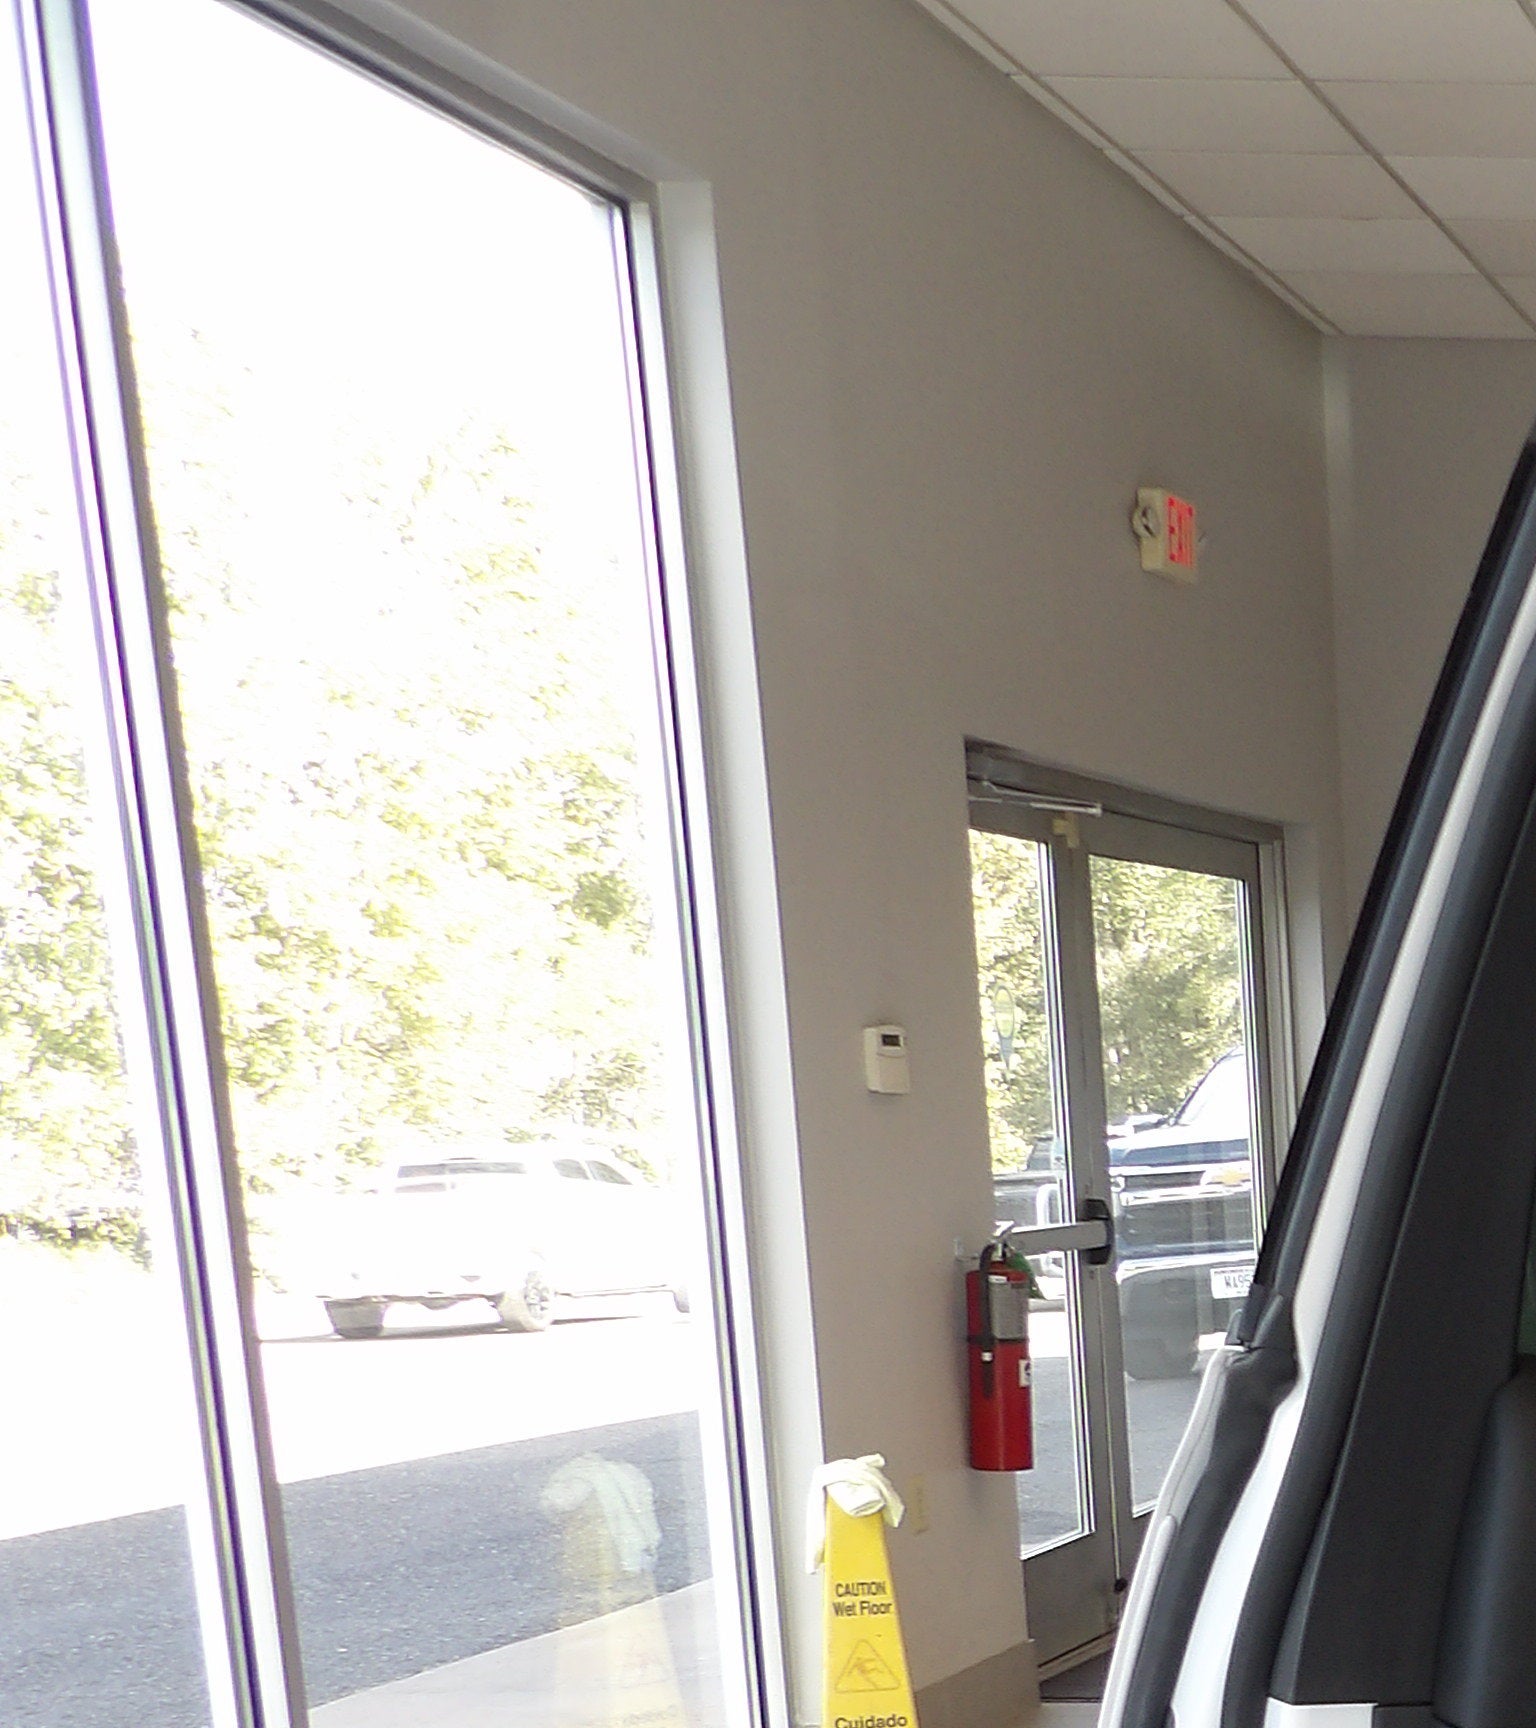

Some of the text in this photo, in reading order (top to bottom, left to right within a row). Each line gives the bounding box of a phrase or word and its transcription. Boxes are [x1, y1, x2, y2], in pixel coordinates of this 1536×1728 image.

[835, 1581, 887, 1597] CAUTION
[832, 1600, 892, 1616] Wet Floor
